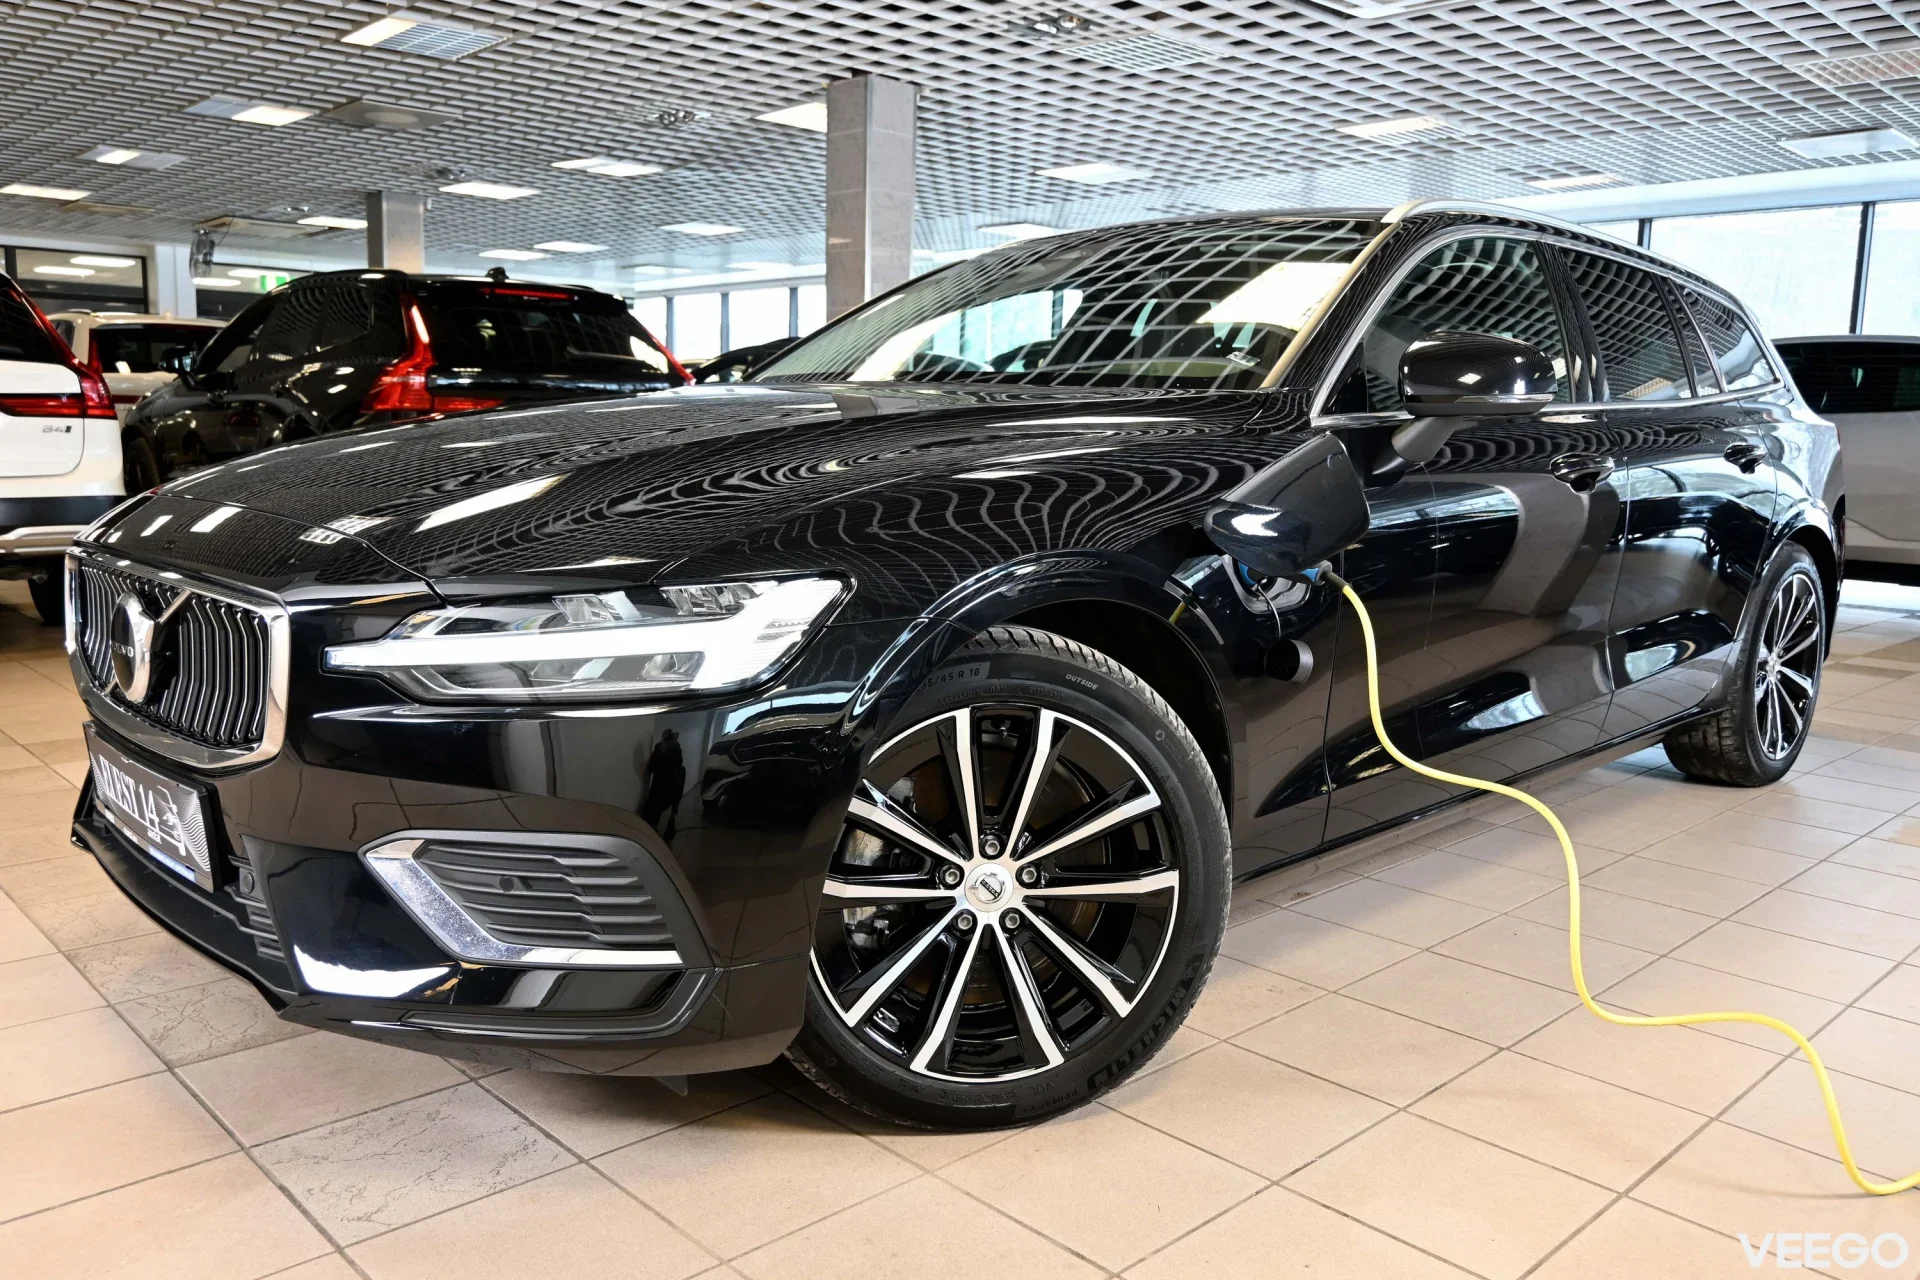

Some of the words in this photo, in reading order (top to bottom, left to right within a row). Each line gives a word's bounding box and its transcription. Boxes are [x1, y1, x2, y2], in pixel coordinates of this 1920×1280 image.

[916, 672, 954, 692] 35/45
[957, 670, 965, 680] R
[969, 667, 980, 677] 18
[1065, 673, 1099, 690] OUTSIDE
[1093, 986, 1187, 1087] MICHELIN
[1029, 1081, 1057, 1095] VOL
